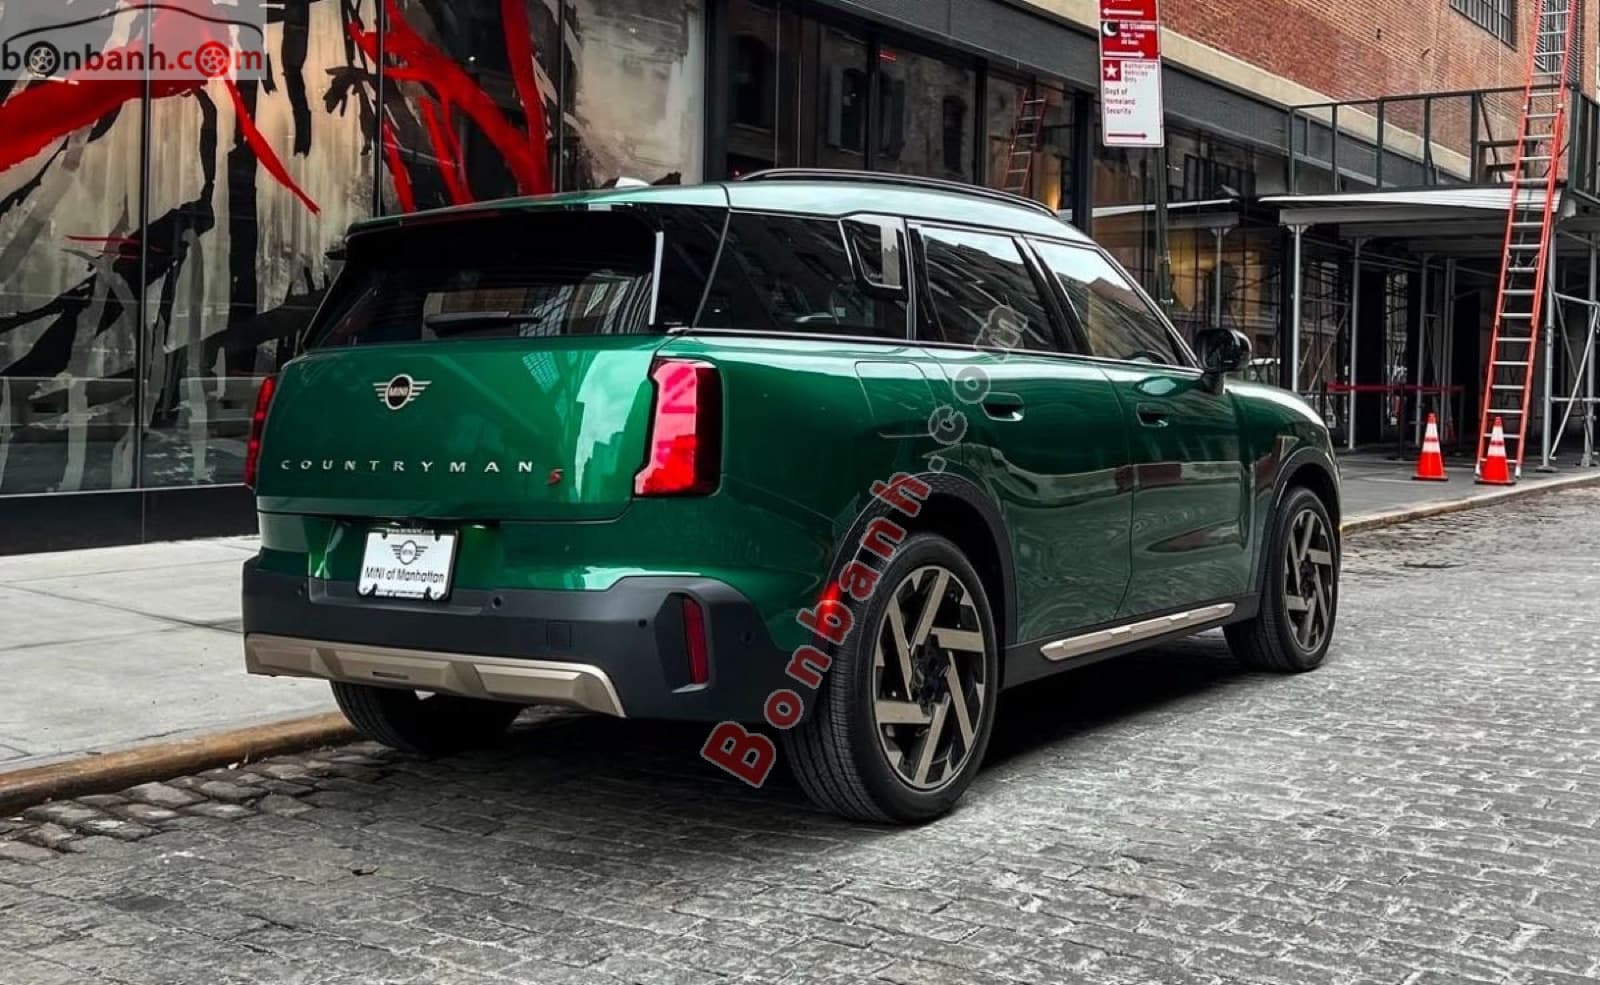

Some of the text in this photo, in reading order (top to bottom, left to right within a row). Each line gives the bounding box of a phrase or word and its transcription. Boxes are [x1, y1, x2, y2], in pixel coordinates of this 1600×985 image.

[1105, 87, 1128, 96] Dept of
[1106, 107, 1132, 115] Security
[388, 386, 409, 397] MINI
[280, 459, 534, 473] COUNTRYMAN
[365, 566, 445, 584] MINI of Manhattan
